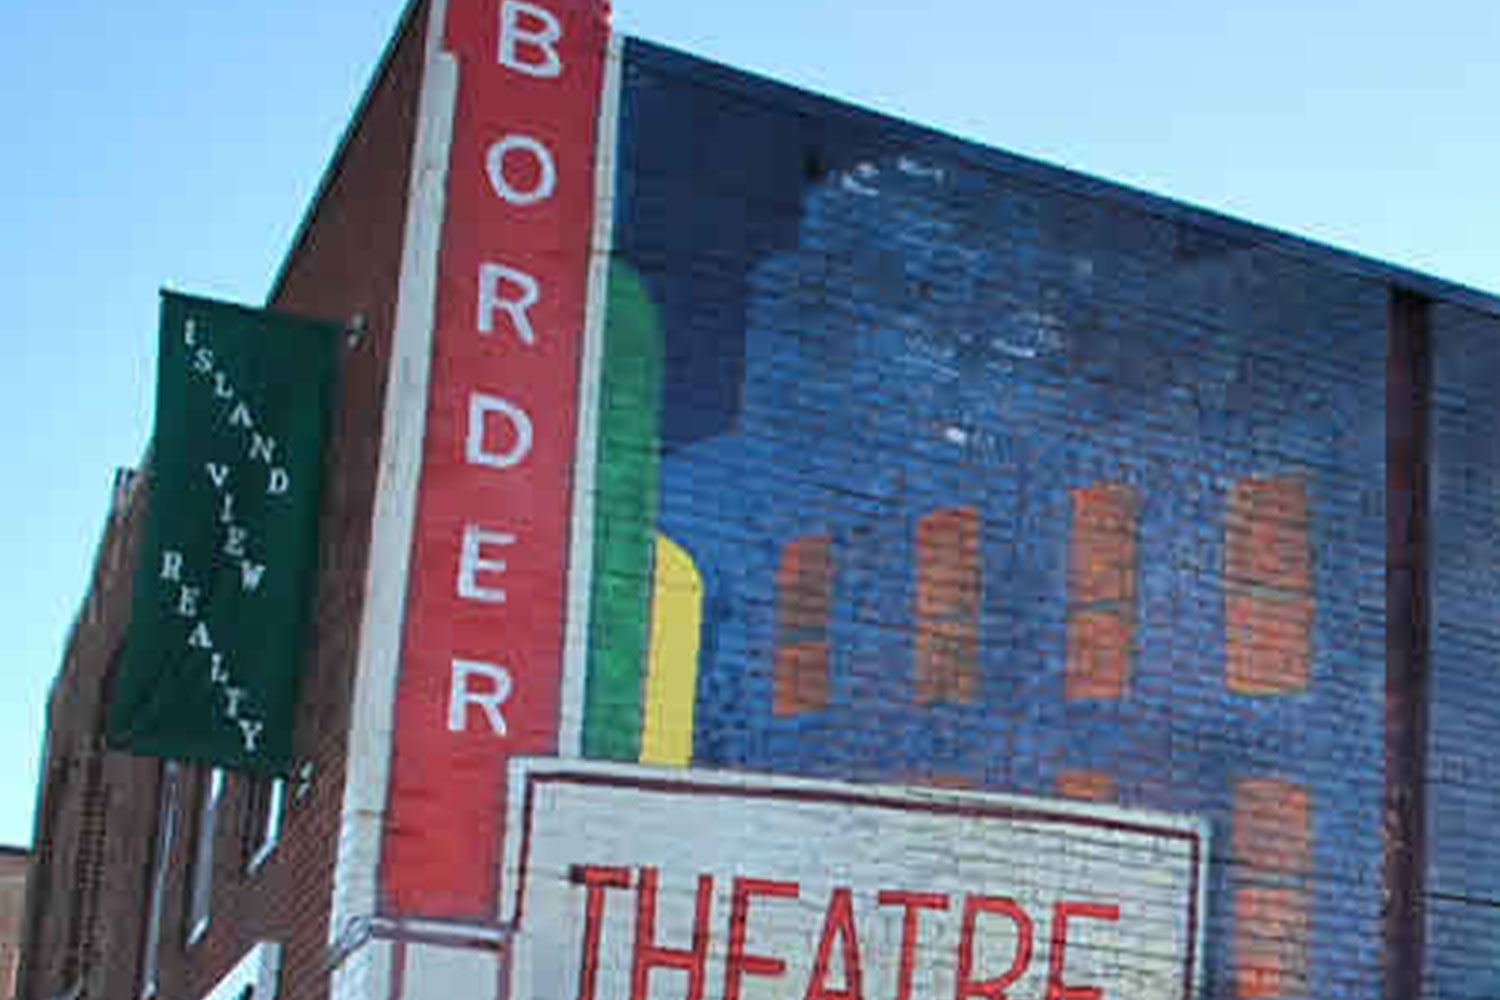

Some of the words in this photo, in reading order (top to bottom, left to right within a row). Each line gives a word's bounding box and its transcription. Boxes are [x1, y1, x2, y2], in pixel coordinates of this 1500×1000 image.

[184, 318, 290, 493] ISLAND
[447, 0, 562, 737] BORDER
[206, 461, 266, 590] VIEW
[160, 550, 264, 751] REALTY
